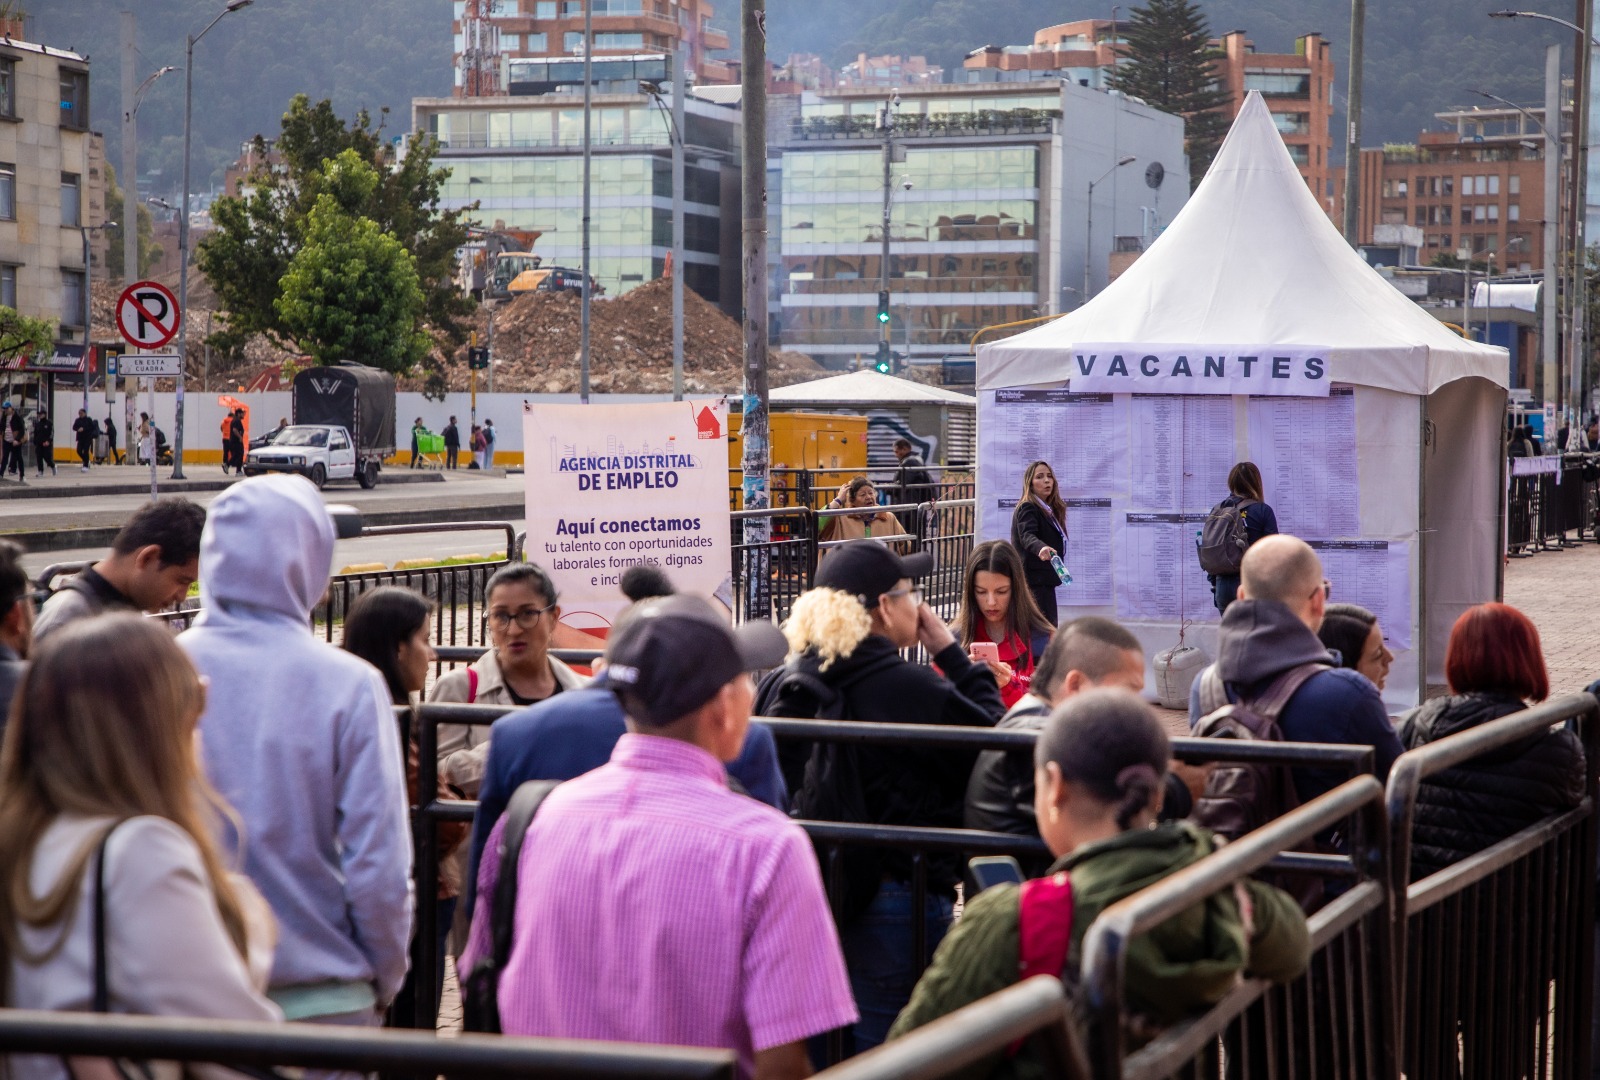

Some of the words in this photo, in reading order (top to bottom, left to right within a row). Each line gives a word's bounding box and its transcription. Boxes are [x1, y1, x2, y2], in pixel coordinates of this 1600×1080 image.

[1077, 355, 1324, 379] VACANTES
[559, 456, 620, 471] AGENCIA
[624, 454, 694, 469] DISTRITAL
[578, 474, 601, 491] DE
[607, 471, 678, 490] EMPLEO
[556, 518, 595, 538] Aquí
[600, 517, 701, 534] conectamos
[545, 543, 557, 552] tu
[560, 540, 601, 552] talento
[604, 541, 626, 550] con
[629, 536, 712, 552] oportunidades
[553, 556, 606, 569] laborales
[609, 555, 662, 568] formales,
[666, 553, 703, 568] dignas
[591, 577, 597, 585] e
